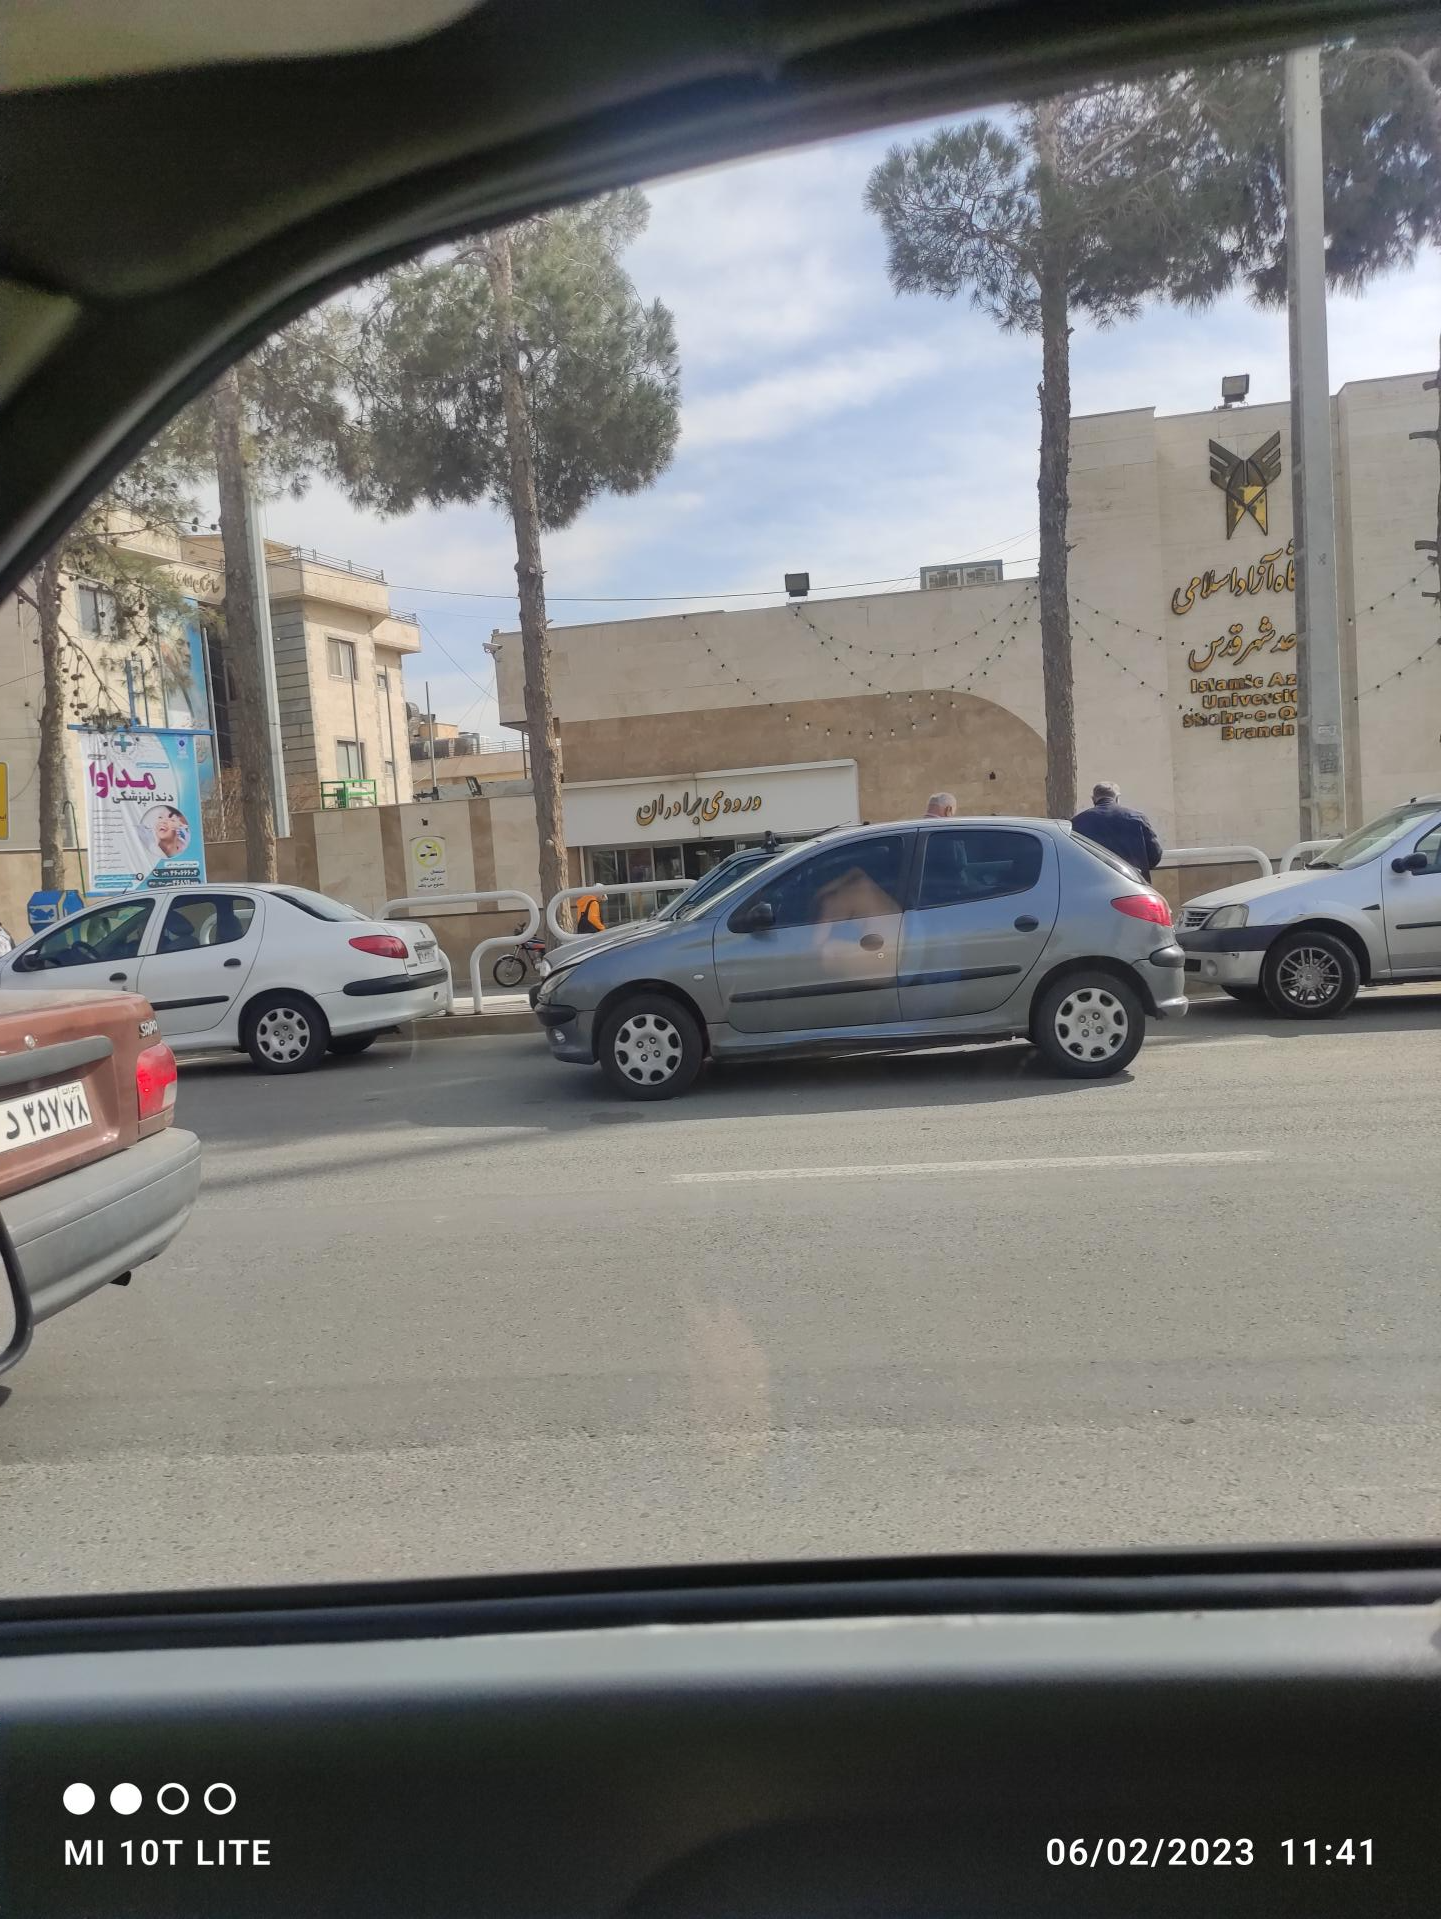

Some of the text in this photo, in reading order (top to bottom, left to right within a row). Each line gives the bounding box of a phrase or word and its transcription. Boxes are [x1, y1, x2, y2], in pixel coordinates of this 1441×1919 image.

[1235, 547, 1283, 597] آزاد
[1171, 566, 1238, 615] اسلامی
[1188, 616, 1297, 672] حد شهر قدس
[1267, 671, 1297, 687] Az
[1202, 689, 1297, 709] Universit
[1182, 706, 1297, 728] Shahr-e-Q
[89, 761, 156, 798] مداوا
[112, 790, 174, 807] دندانپزشکی
[636, 791, 702, 826] برادران
